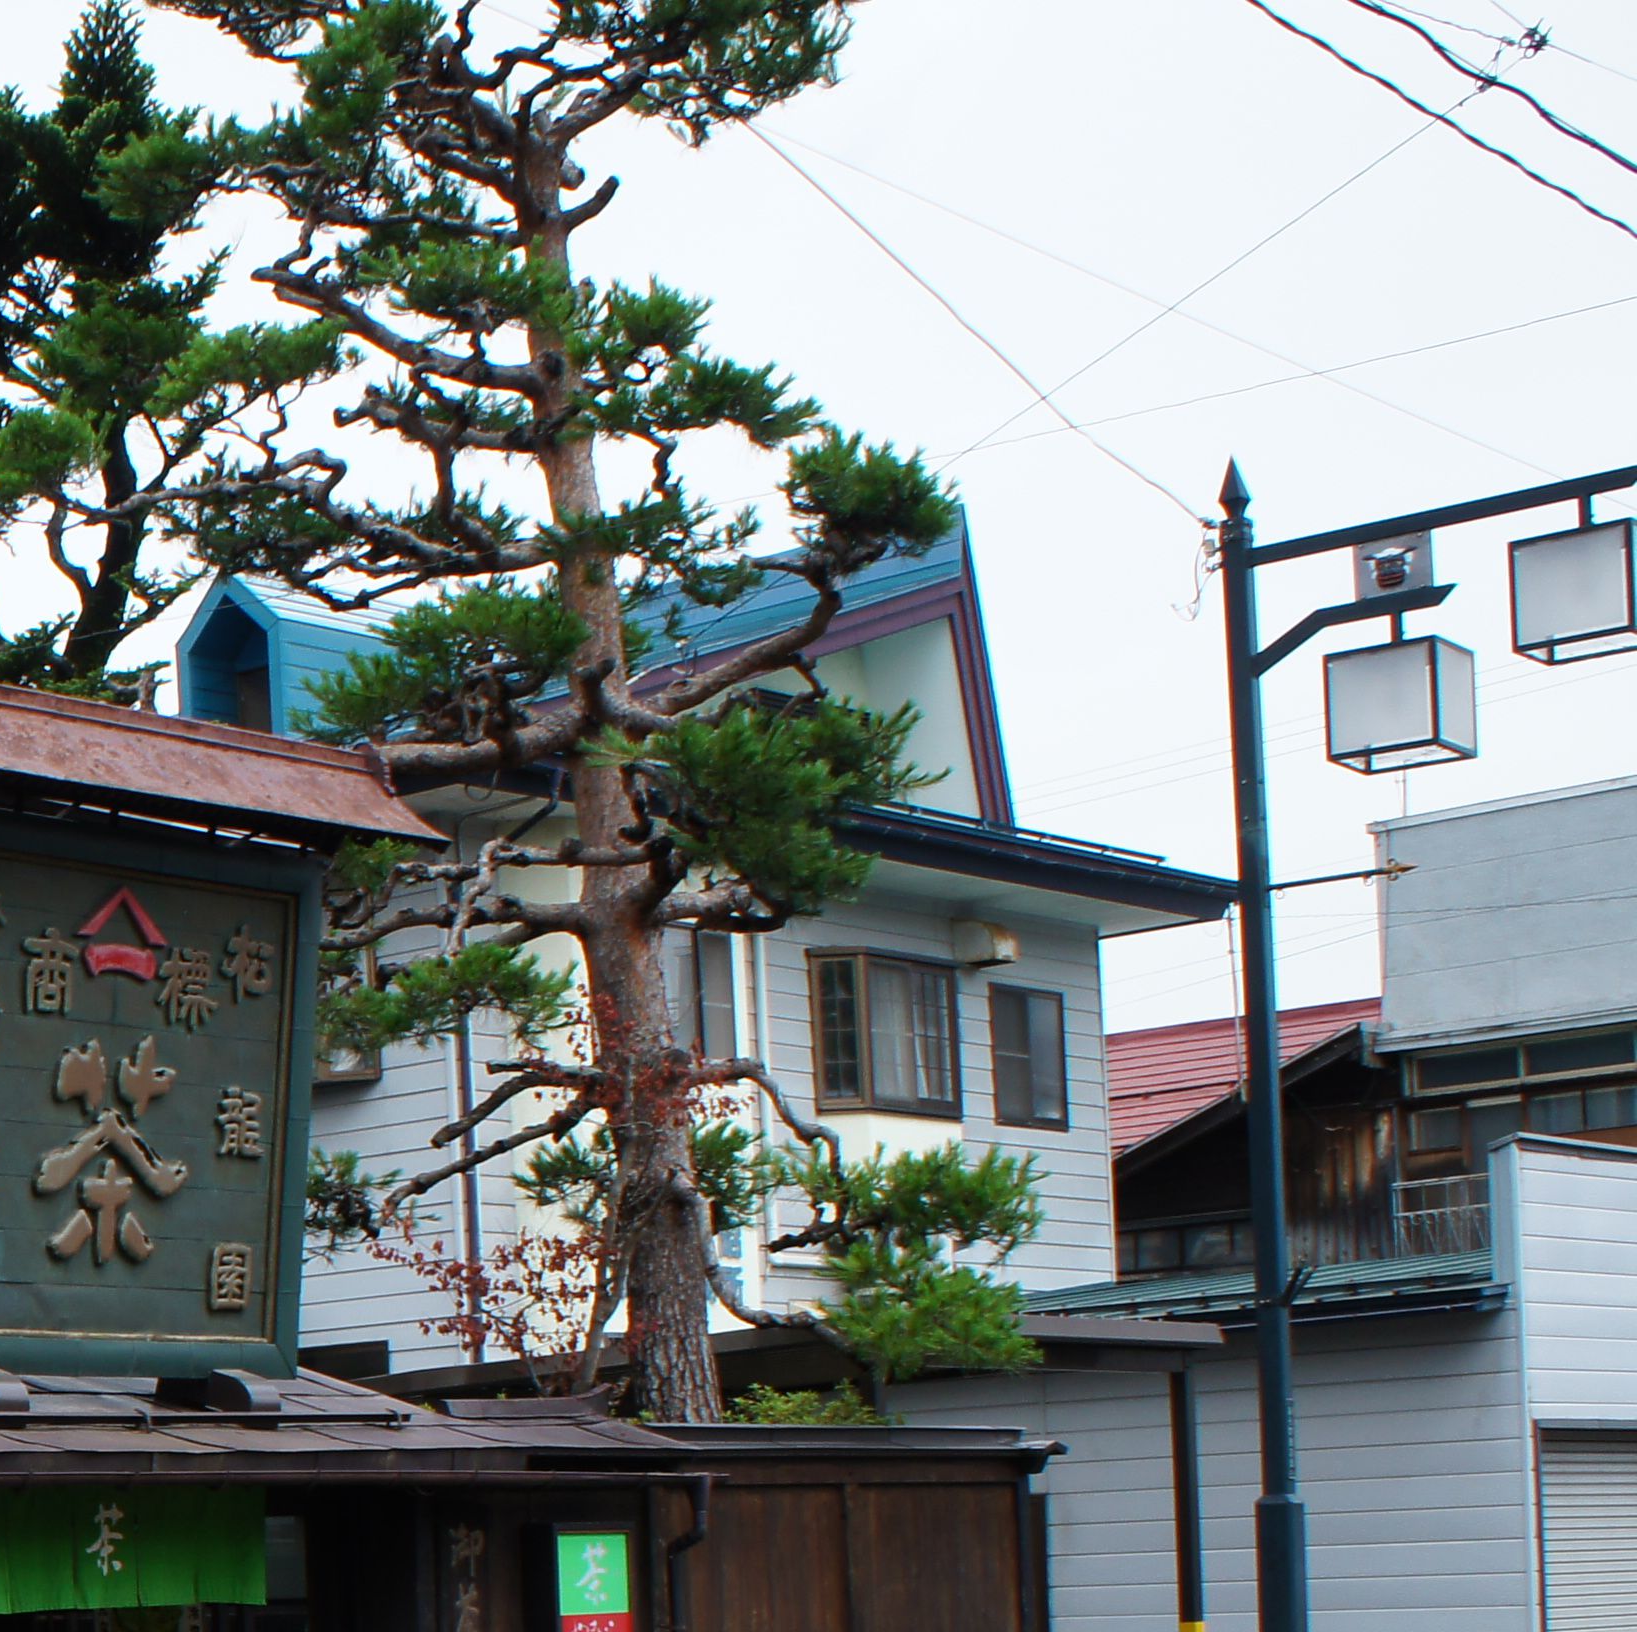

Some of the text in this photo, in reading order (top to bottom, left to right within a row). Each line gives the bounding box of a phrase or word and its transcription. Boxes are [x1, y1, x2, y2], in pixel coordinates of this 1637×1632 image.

[32, 1033, 188, 1264] 茶
[85, 1503, 124, 1577] 茶
[575, 1542, 608, 1606] 茶
